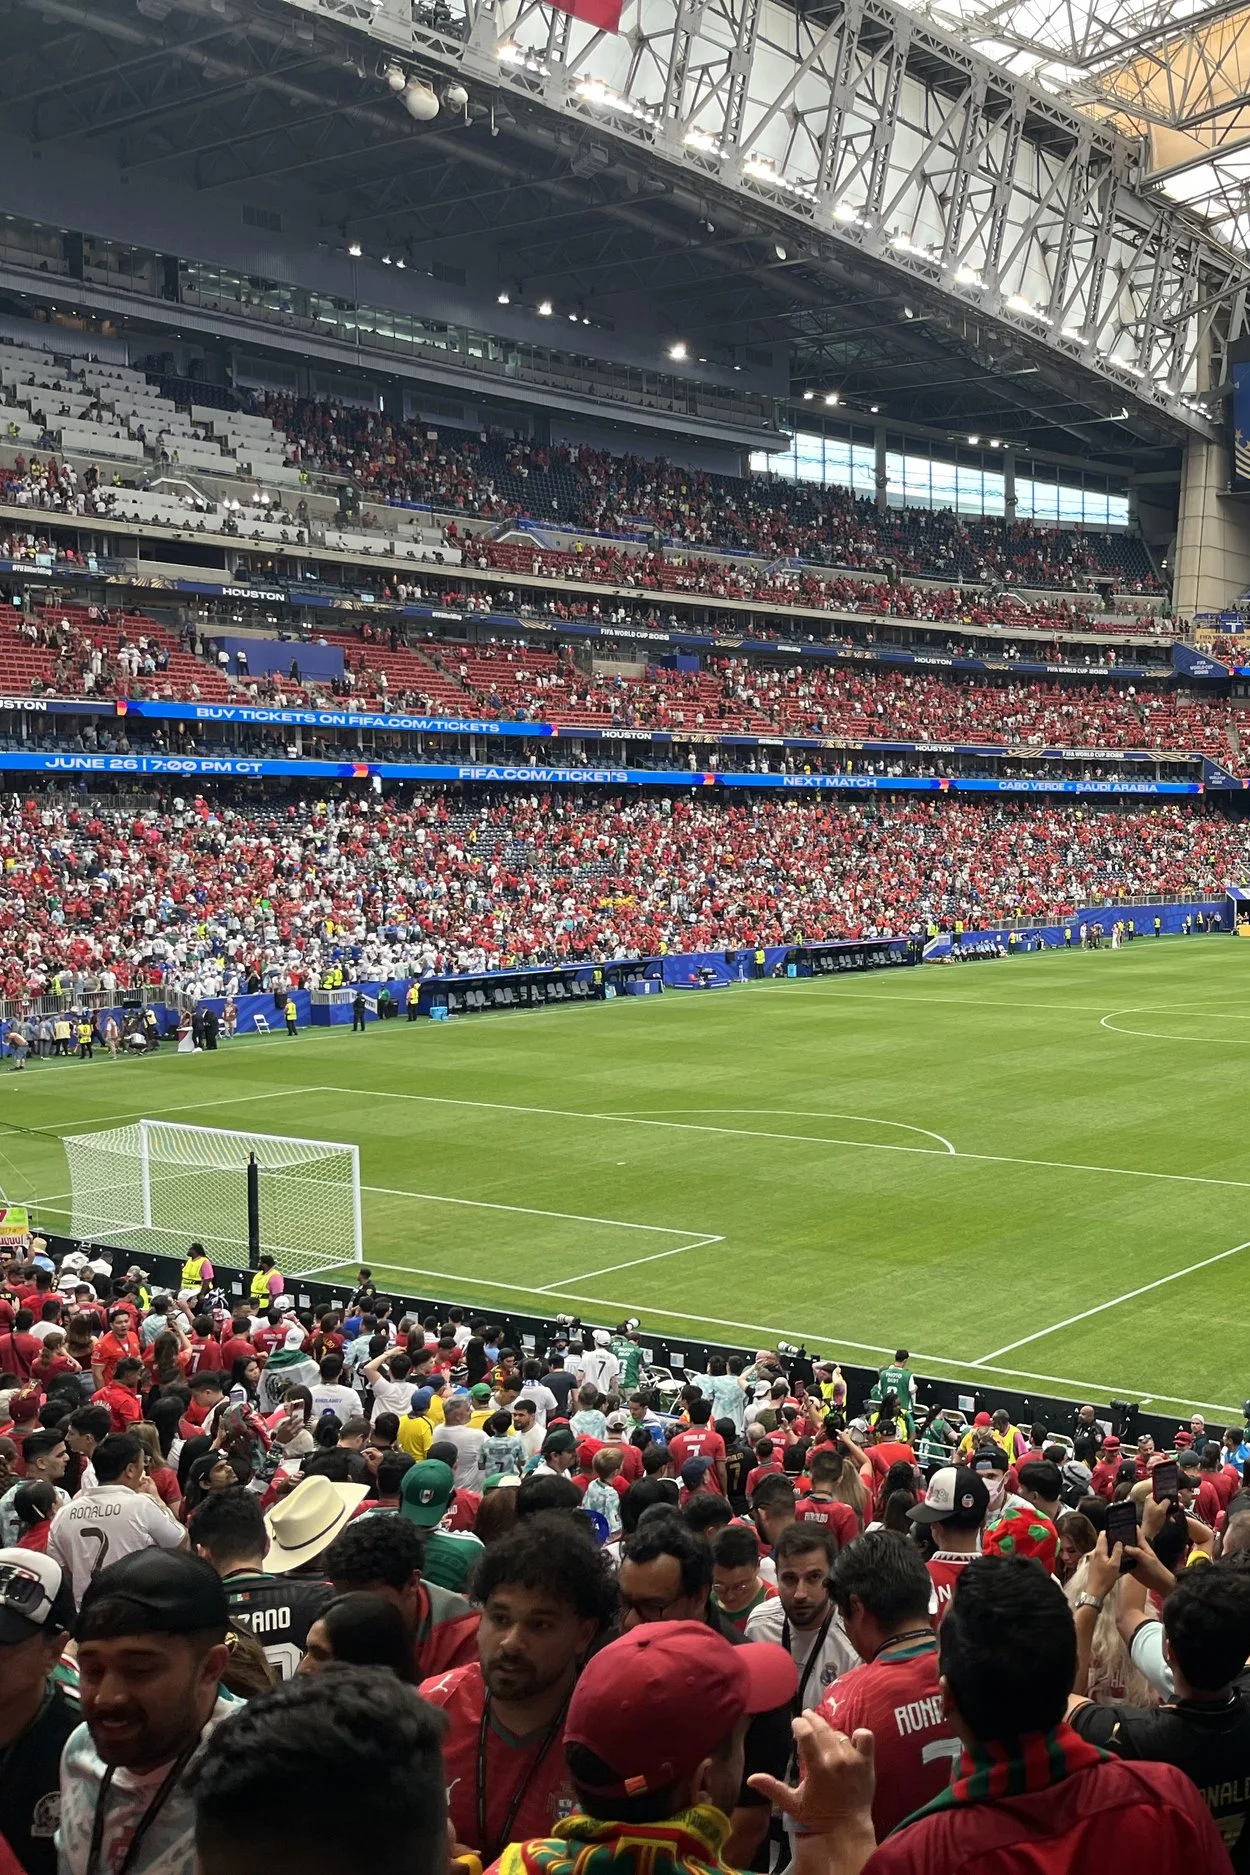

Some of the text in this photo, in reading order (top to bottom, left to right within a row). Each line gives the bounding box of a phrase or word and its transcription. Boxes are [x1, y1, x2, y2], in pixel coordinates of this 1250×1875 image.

[222, 587, 285, 601] HOUSTON
[600, 628, 614, 637] FIFA
[615, 629, 635, 638] WORLD
[636, 631, 648, 639] CUP
[914, 656, 952, 666] HOUSTON
[196, 708, 500, 733] BUY TICKETS ON FIFA.COM/TICKETS
[601, 730, 652, 740] HOUSTON
[915, 744, 955, 753] HOUSTON
[45, 757, 105, 769] JUNE
[109, 759, 138, 770] 26
[152, 760, 197, 772] 7:00
[201, 761, 232, 772] PM
[235, 762, 263, 773] CT
[459, 767, 628, 783] FIFA.COM/TICKETS
[784, 776, 877, 787] NEXT MATCH
[999, 781, 1030, 791] CABO
[1031, 781, 1065, 792] VERDE
[1076, 782, 1112, 792] SAUDI
[1114, 783, 1158, 793] ARABIA
[598, 1361, 606, 1374] 7
[70, 1504, 121, 1520] RONALDO
[80, 1527, 109, 1580] 7
